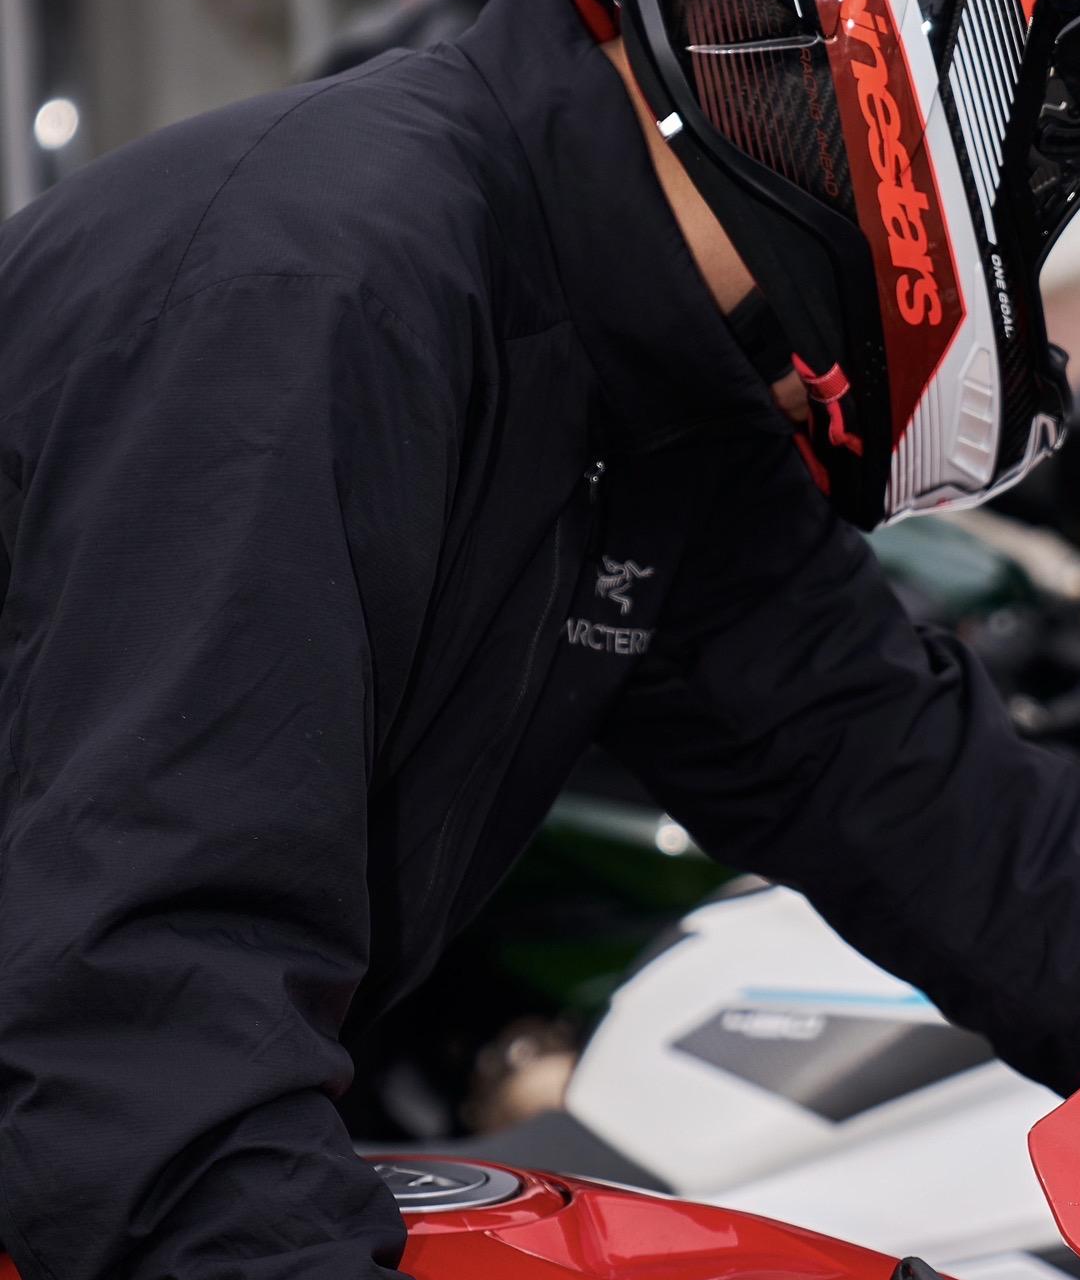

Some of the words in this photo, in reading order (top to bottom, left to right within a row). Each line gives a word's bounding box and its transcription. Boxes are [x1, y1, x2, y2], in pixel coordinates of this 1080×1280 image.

[800, 48, 824, 124] RACING
[816, 126, 840, 198] AHEAD
[991, 253, 1007, 290] ONE
